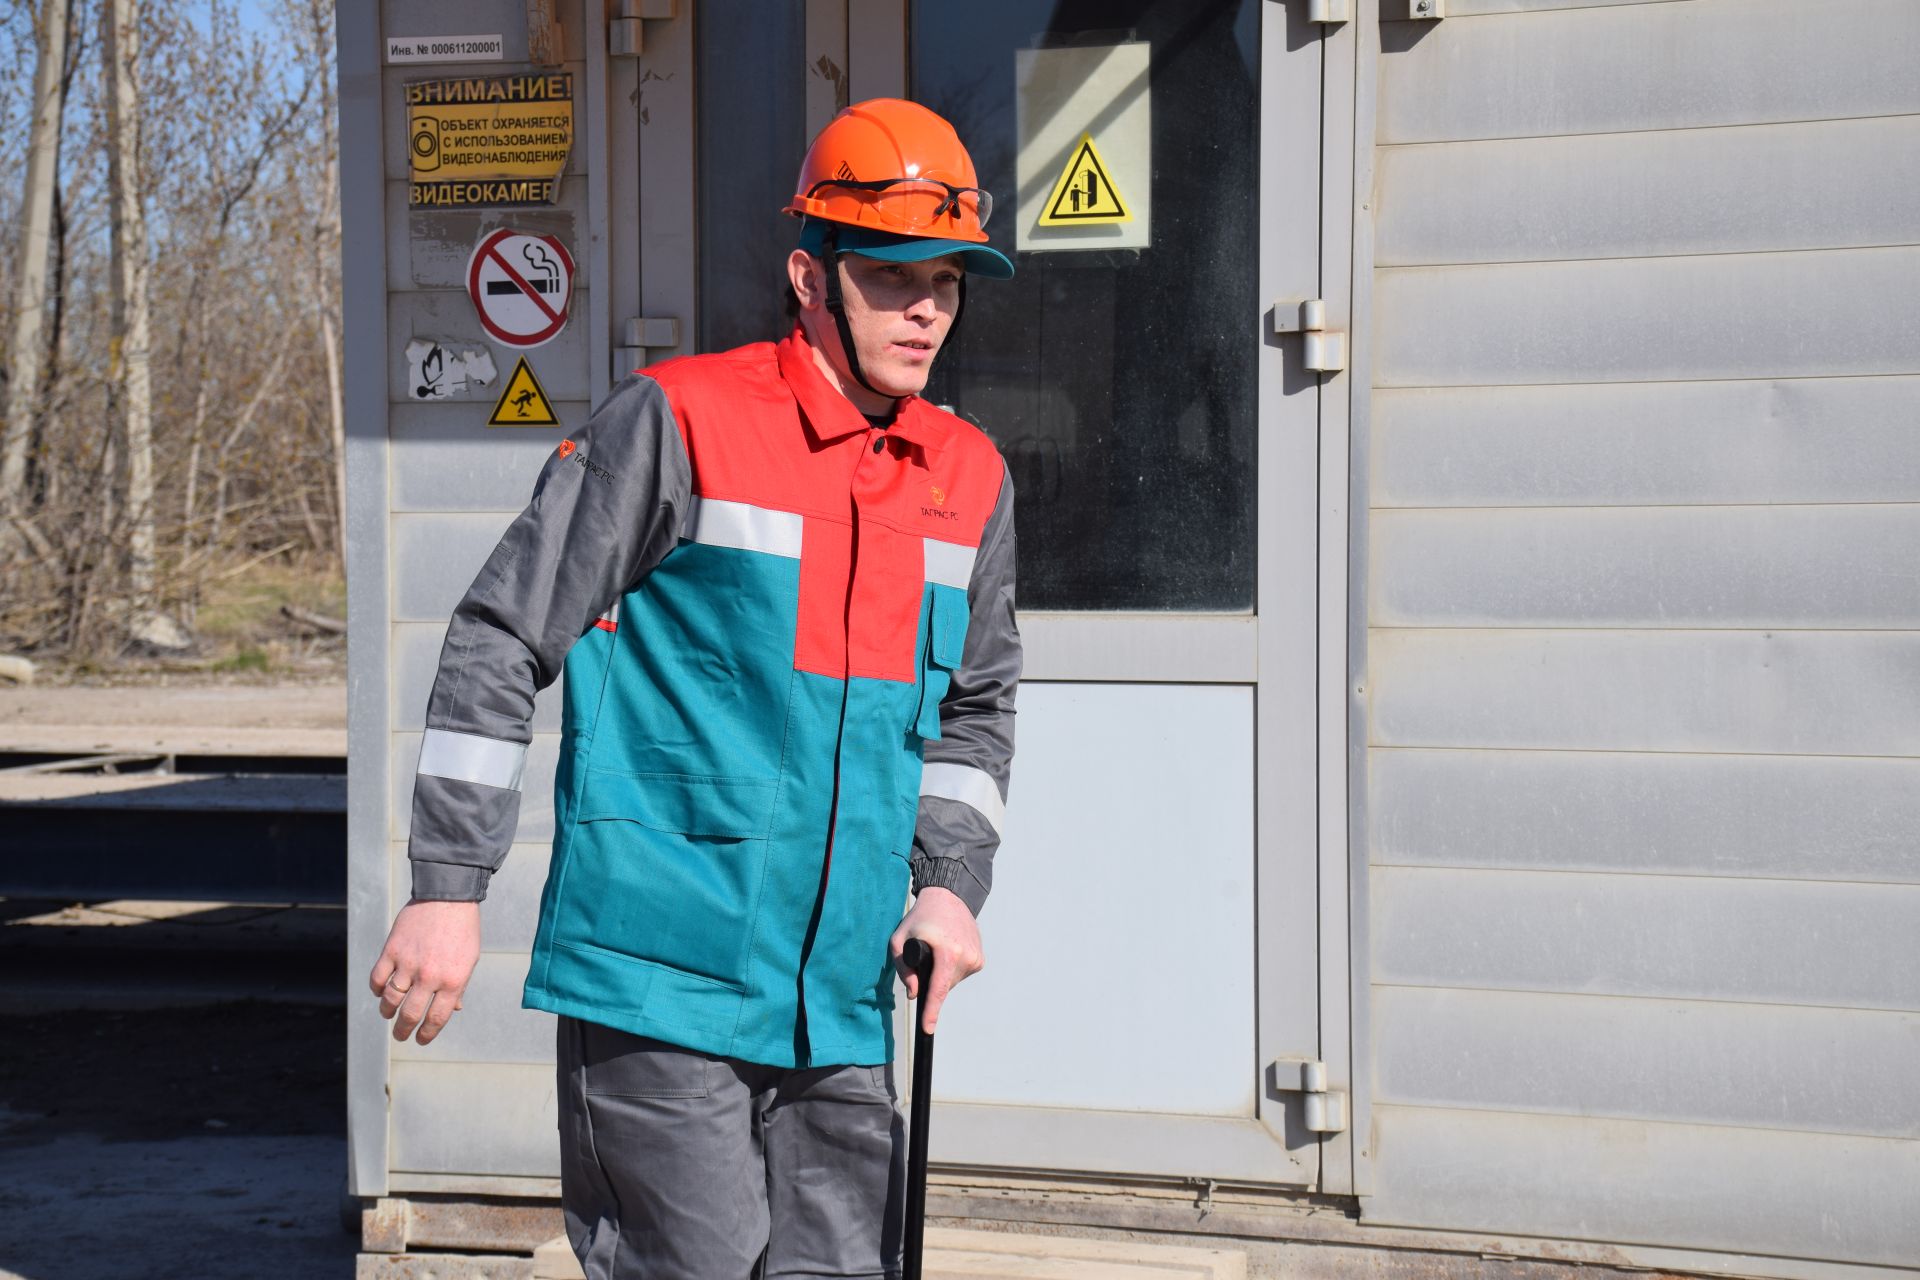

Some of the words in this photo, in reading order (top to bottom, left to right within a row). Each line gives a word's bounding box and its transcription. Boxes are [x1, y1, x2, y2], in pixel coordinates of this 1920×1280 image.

[391, 45, 414, 56] Инв.
[417, 44, 429, 55] №
[431, 41, 501, 55] 000611200001
[406, 76, 571, 102] ВНИМАНИЕ!
[441, 119, 488, 131] ОБЪЕКТ
[492, 116, 569, 130] ОХРАНЯЕТСЯ
[443, 136, 452, 149] С
[455, 133, 568, 148] ИСПОЛЬЗОВАНИЕМ
[409, 182, 552, 205] ВИДЕОКАМЕР
[921, 507, 949, 519] ТАГРАС
[950, 511, 959, 520] РС
